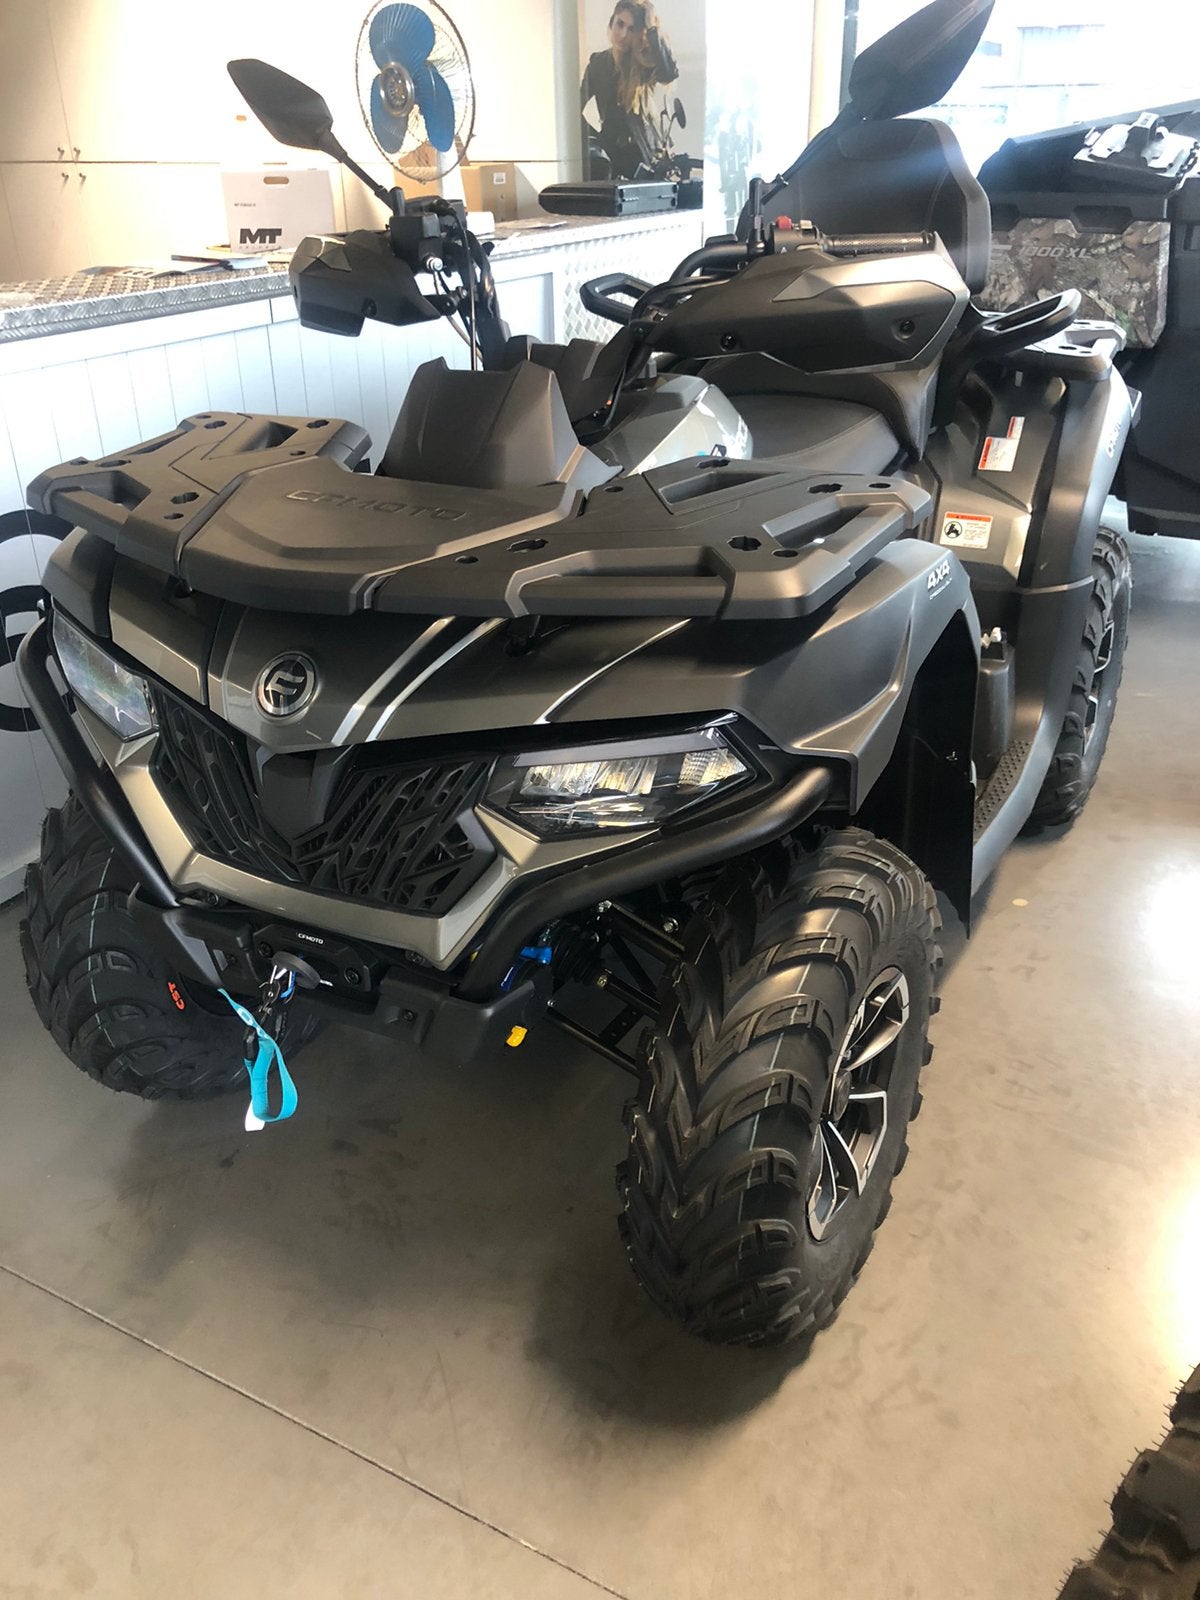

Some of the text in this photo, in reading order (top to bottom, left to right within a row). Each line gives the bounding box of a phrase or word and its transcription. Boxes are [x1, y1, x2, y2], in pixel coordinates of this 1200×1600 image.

[240, 228, 282, 244] MT
[1019, 246, 1065, 257] 1000
[1066, 247, 1092, 259] XL
[286, 489, 466, 521] CFMOTO
[298, 933, 324, 944] CFMOTO
[168, 981, 185, 1010] CST
